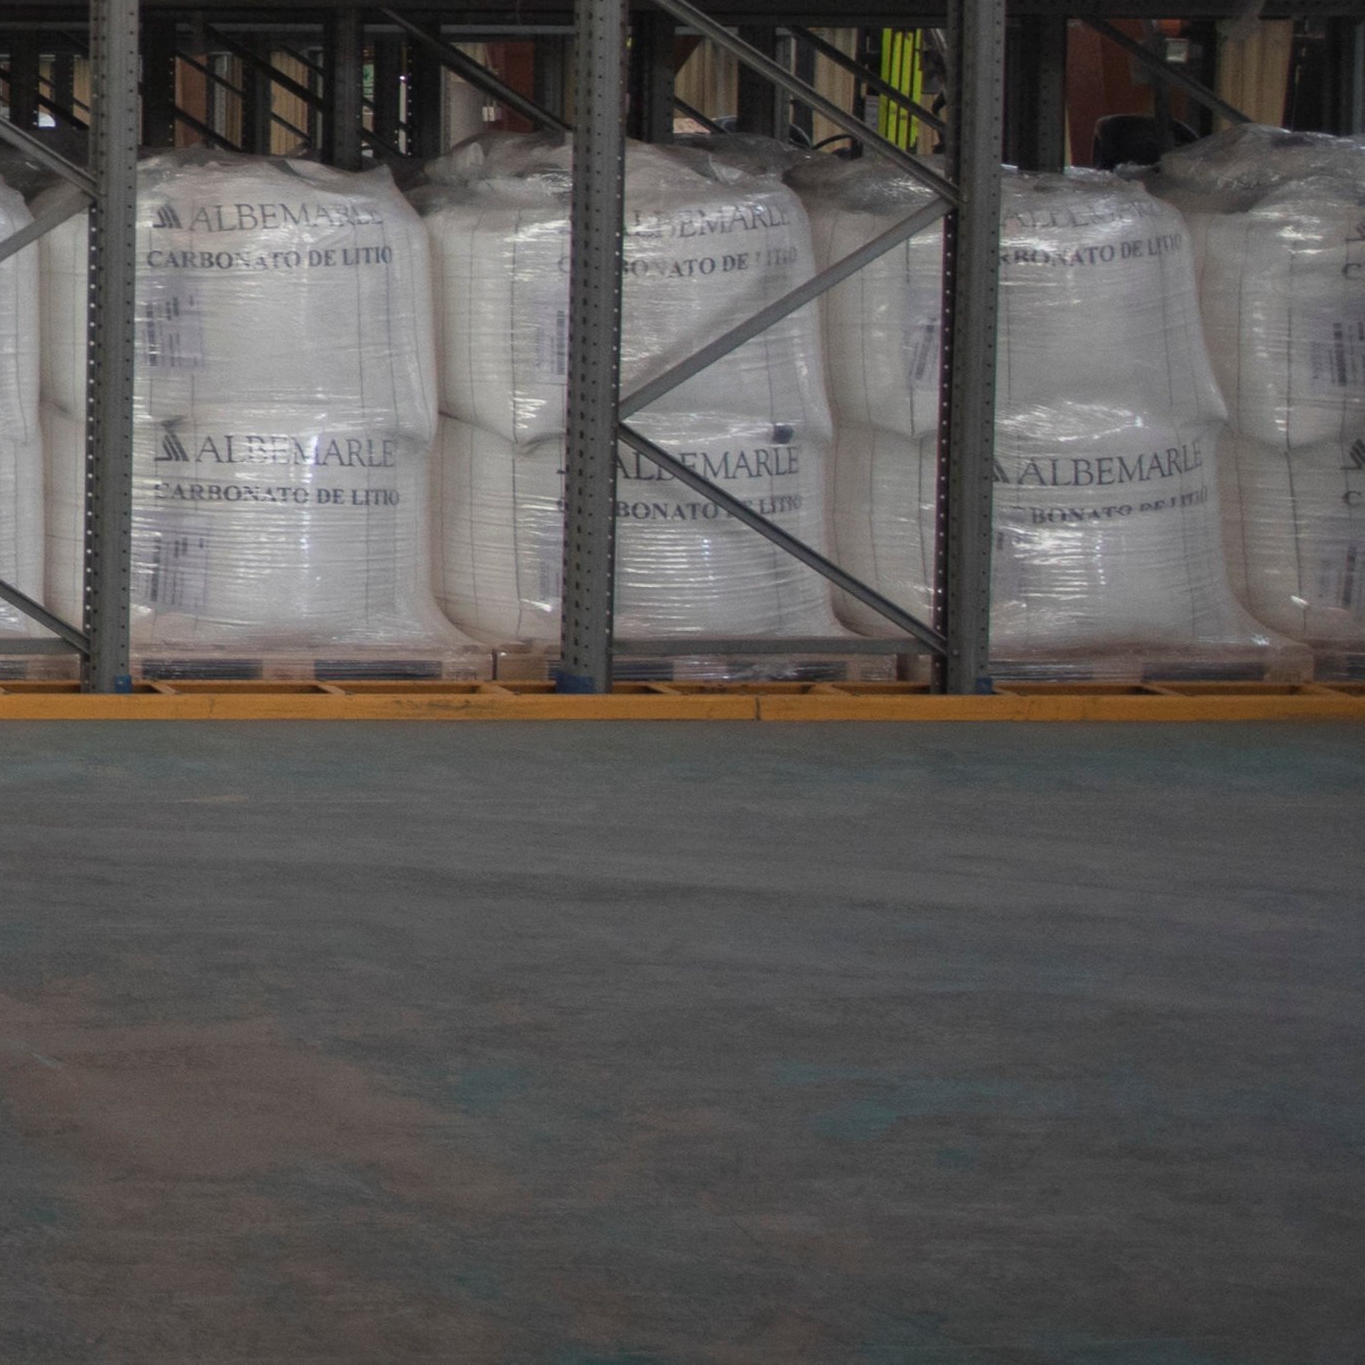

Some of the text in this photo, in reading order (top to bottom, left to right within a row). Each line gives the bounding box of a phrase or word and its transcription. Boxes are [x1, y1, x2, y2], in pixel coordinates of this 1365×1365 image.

[189, 203, 384, 233] ALBEMARLE
[146, 246, 393, 270] CARBONATO DE LITIO
[722, 252, 749, 270] DE
[999, 243, 1116, 267] RBONATO
[1122, 241, 1144, 259] DE
[195, 434, 396, 468] ALBEMARLE
[619, 446, 801, 482] ALEMARLE
[1019, 443, 1203, 487] ALBEMARLE
[154, 483, 401, 507] CARBONATO DE LITIO
[617, 500, 721, 520] BONATO
[1029, 502, 1133, 525] BONATO
